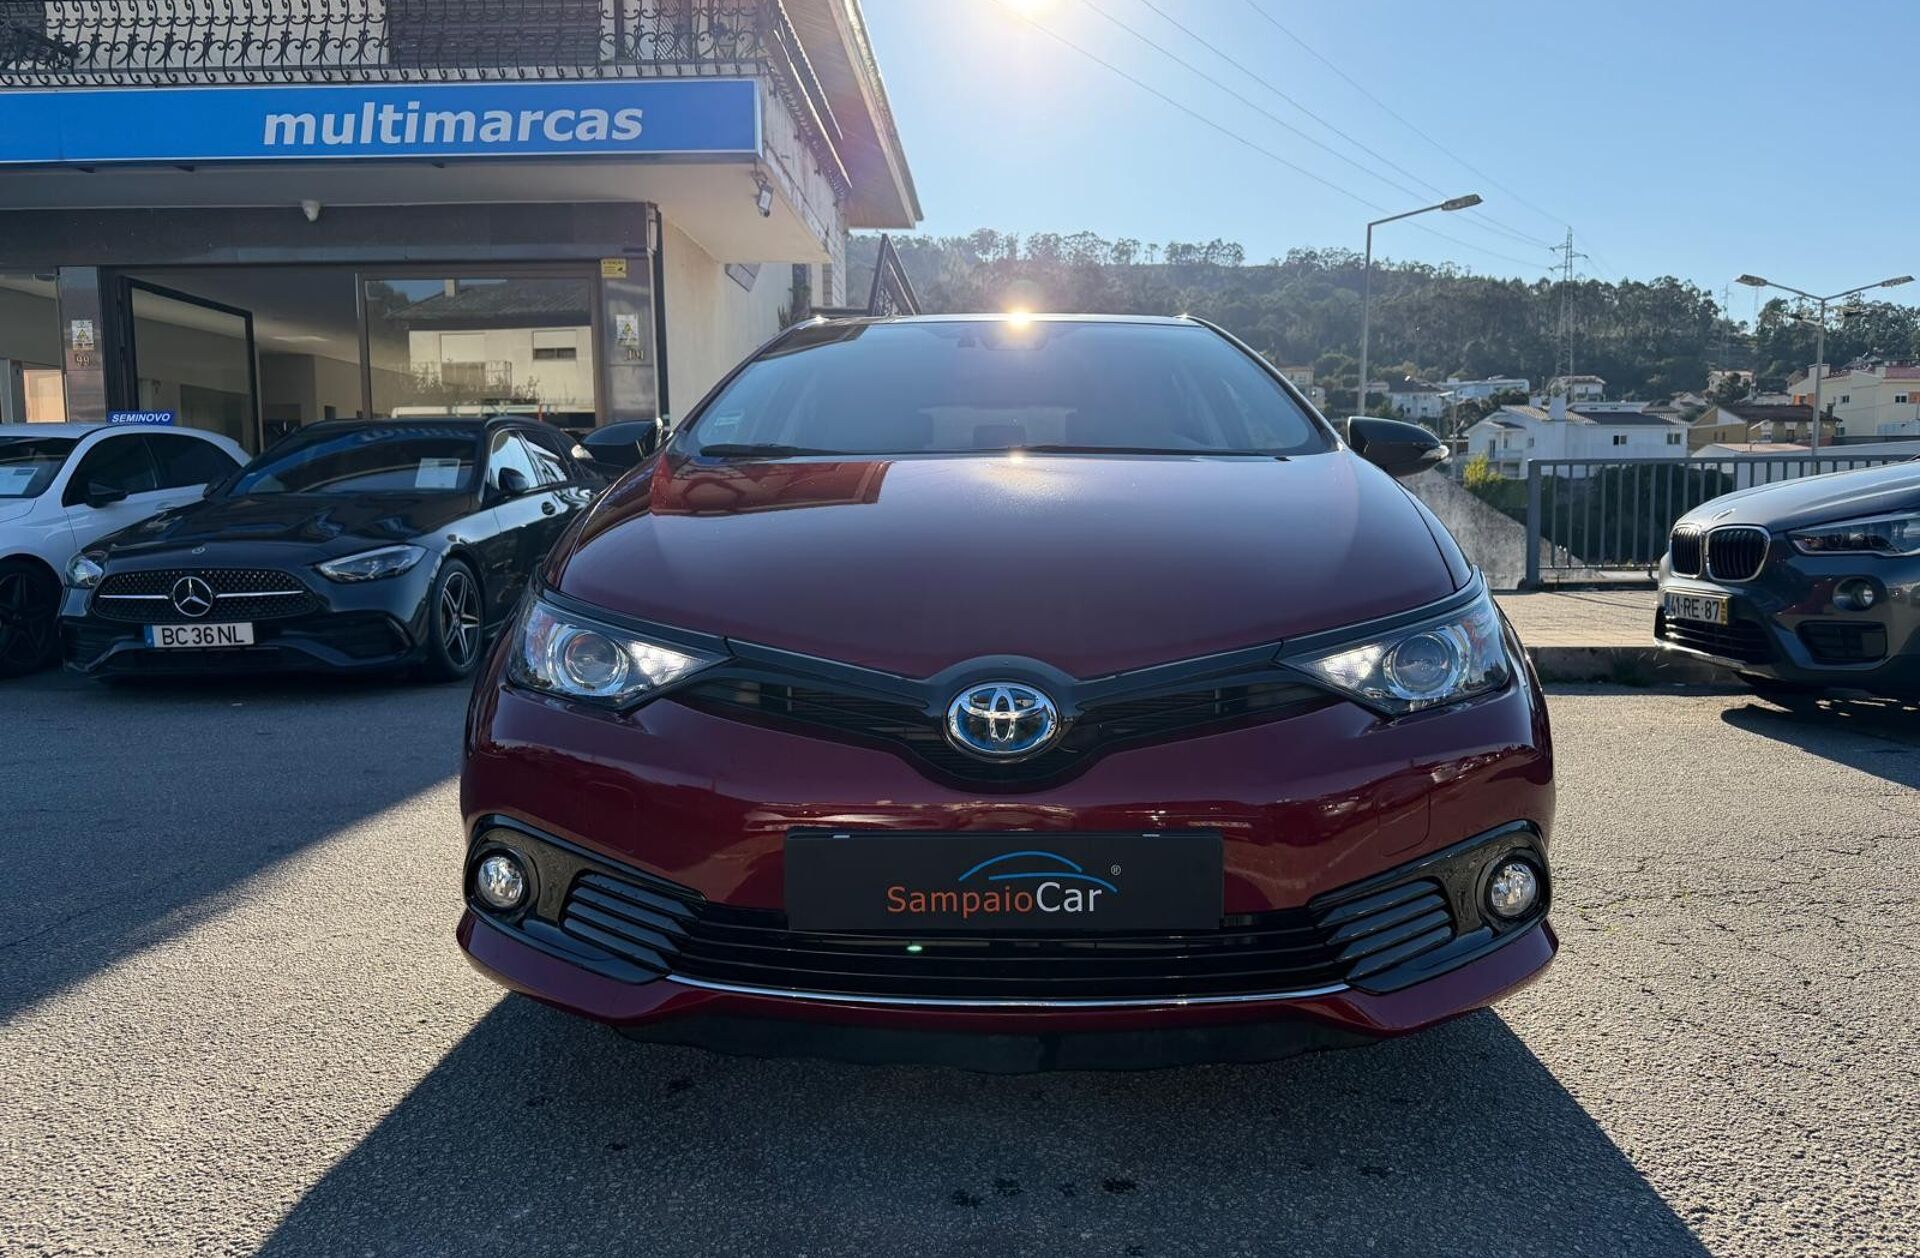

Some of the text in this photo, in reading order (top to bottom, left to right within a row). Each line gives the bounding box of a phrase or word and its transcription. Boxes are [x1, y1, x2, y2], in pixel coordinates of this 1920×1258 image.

[263, 101, 644, 145] multimarcas
[111, 412, 171, 423] SEMINOVO
[161, 625, 245, 646] BC 36 NL
[886, 881, 1103, 919] SampaioCar
